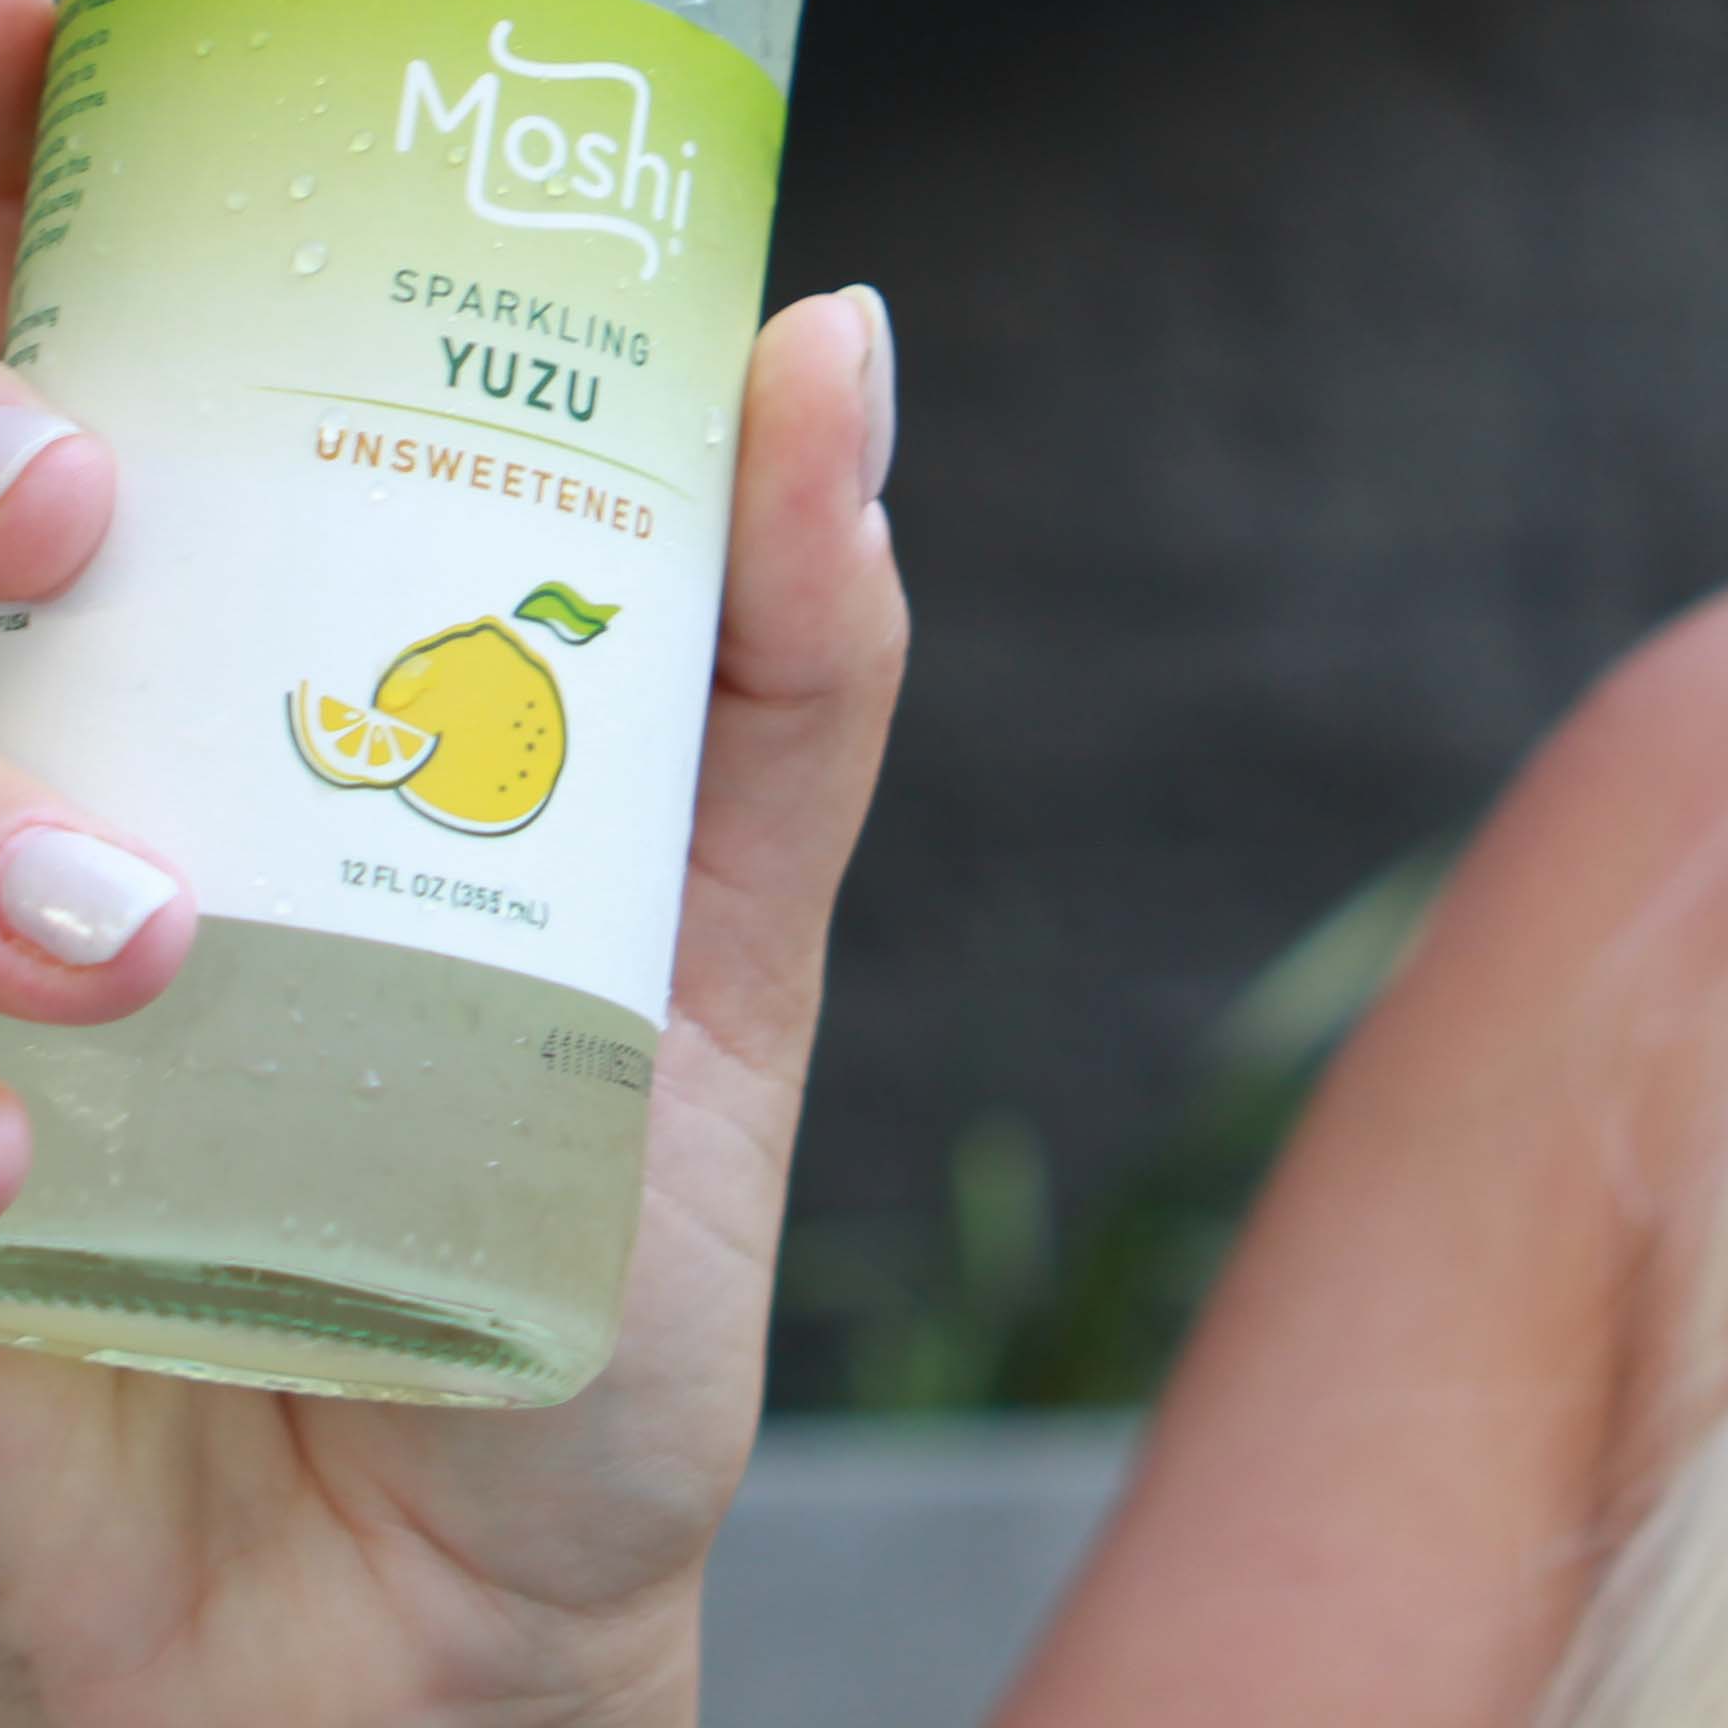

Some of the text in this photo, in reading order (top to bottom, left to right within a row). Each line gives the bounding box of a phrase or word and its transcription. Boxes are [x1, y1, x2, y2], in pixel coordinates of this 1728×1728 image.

[394, 20, 698, 280] Moshi
[388, 268, 651, 366] SPARKLING
[439, 335, 600, 422] YUZU
[314, 426, 654, 540] UNSWEETENED
[340, 859, 368, 886] 12
[373, 864, 404, 893] FL
[412, 873, 446, 901] OZ
